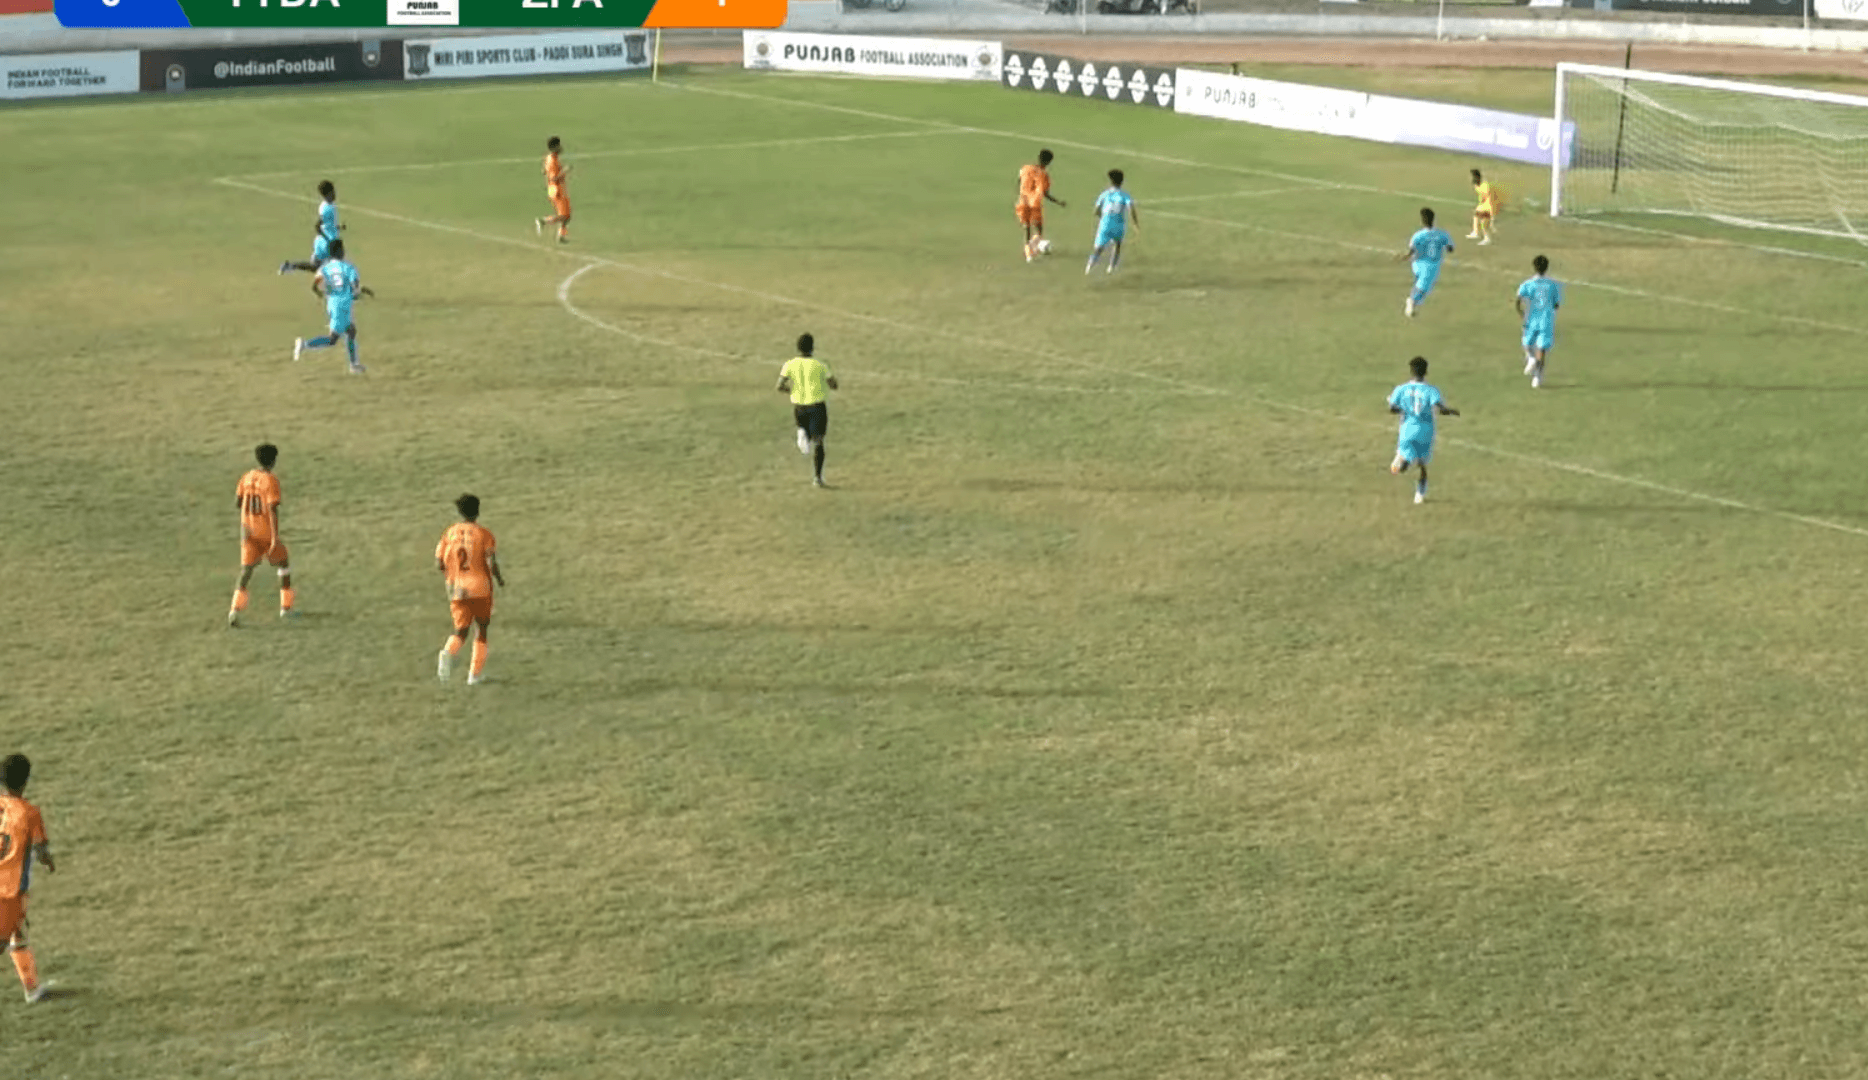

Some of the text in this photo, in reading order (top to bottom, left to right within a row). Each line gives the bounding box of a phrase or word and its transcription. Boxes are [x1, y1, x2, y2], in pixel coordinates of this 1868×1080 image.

[476, 48, 511, 64] SPORTS
[512, 47, 536, 63] CLUB
[784, 44, 968, 67] PUNJAB FOOTBALL ASSOCIATION
[214, 56, 336, 79] @IndianFootball
[1205, 86, 1256, 109] PUNJAB
[245, 493, 263, 516] 10
[457, 546, 471, 571] 2
